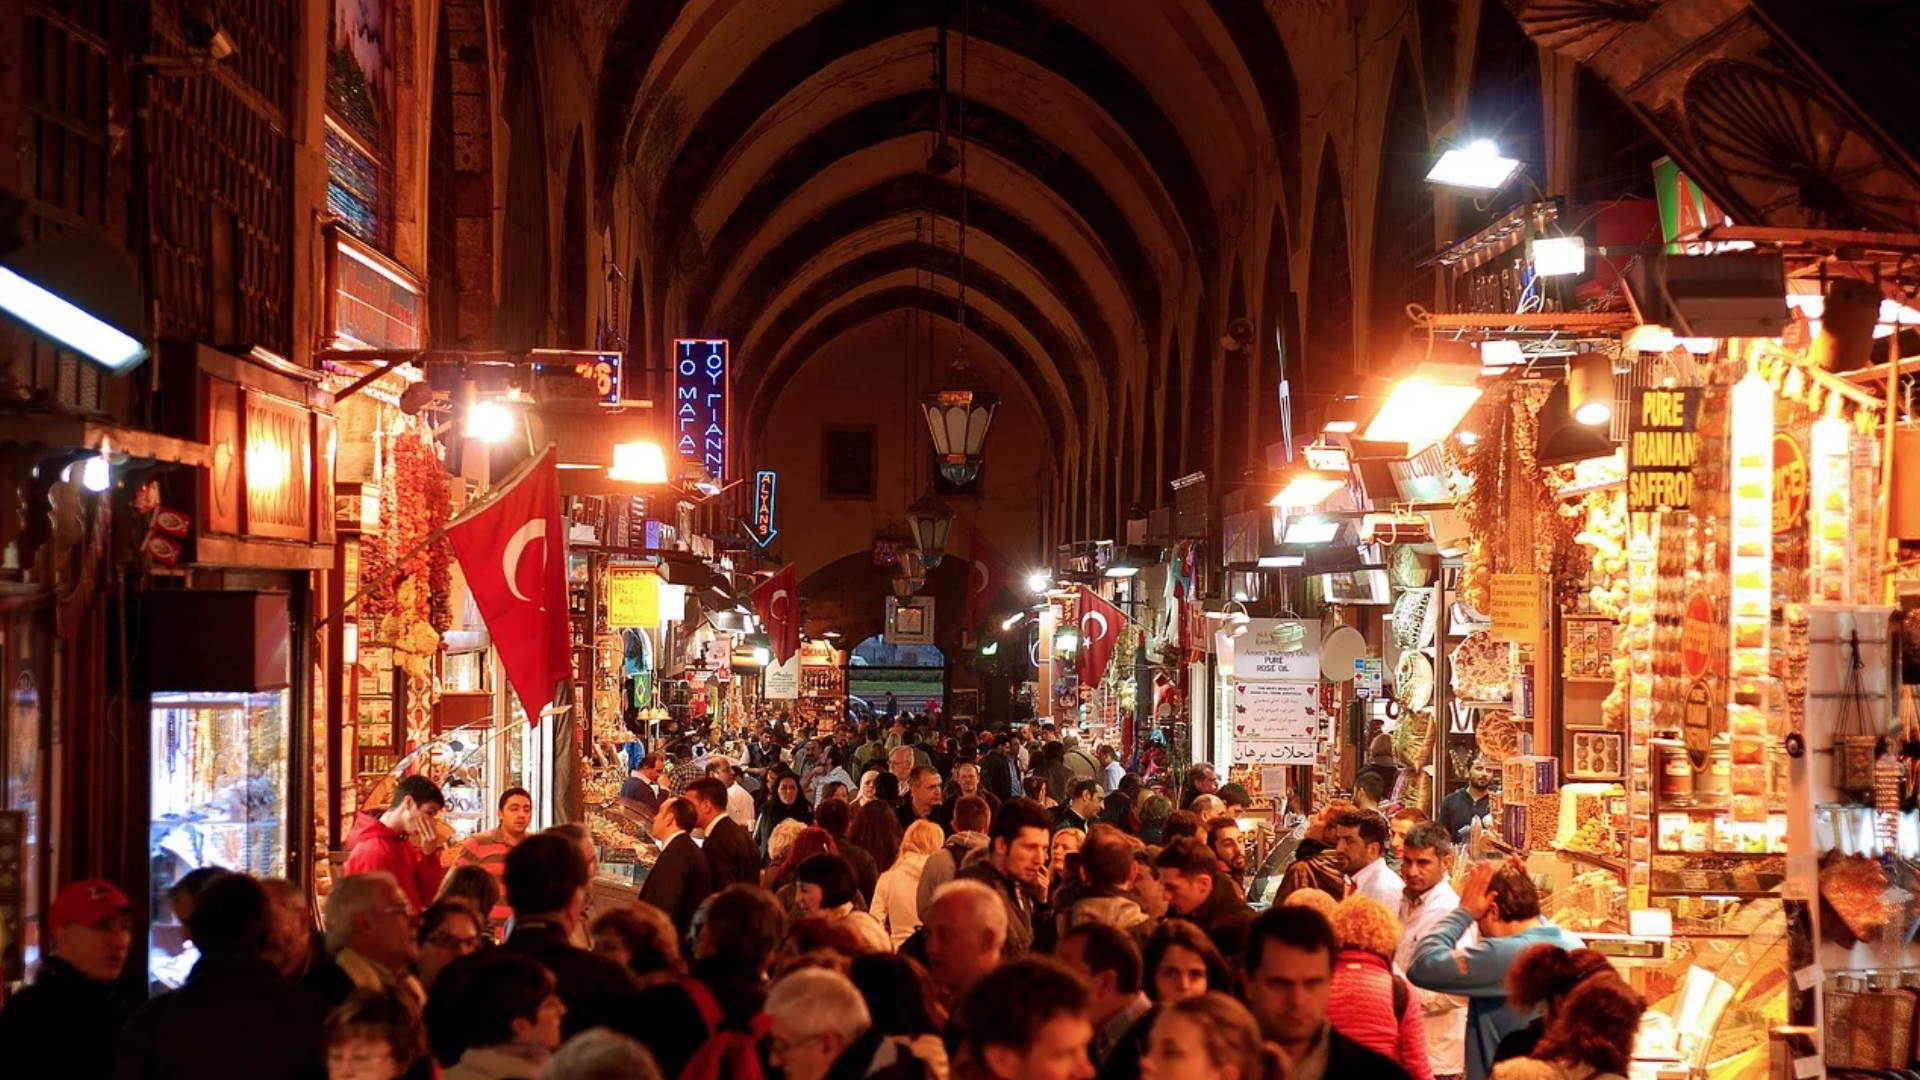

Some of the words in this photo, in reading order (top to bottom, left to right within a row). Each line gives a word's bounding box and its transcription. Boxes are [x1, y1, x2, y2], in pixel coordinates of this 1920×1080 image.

[679, 387, 697, 455] ΜΑΓΑ
[1642, 392, 1685, 426] PURE
[1633, 431, 1698, 466] IRANIAN
[759, 474, 771, 535] ALYANS
[1234, 744, 1267, 762] برهان
[1271, 745, 1314, 760] محلات
